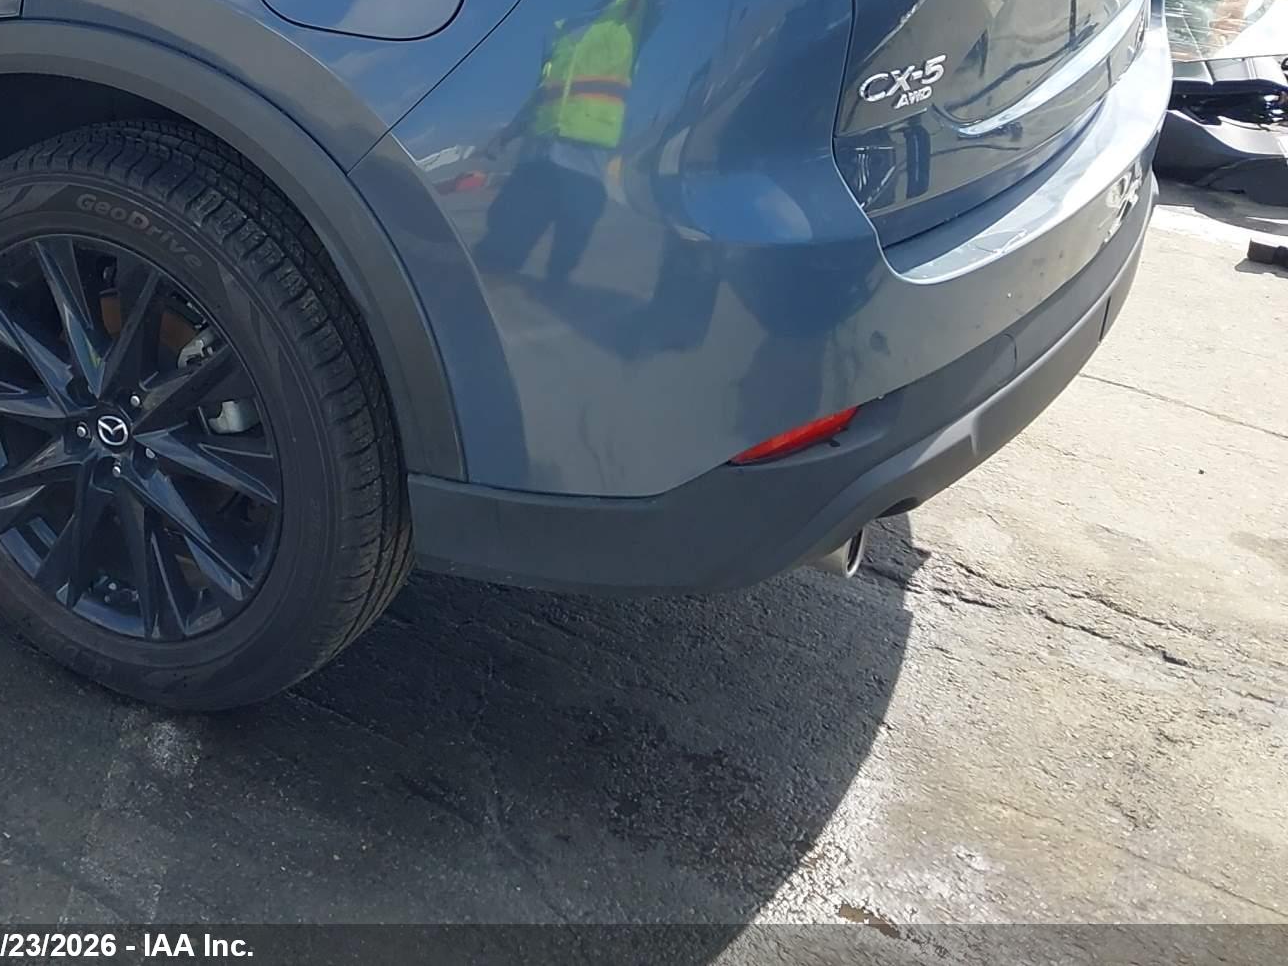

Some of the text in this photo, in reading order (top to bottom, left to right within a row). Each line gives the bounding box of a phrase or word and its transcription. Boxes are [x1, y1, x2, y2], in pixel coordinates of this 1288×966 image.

[859, 54, 946, 102] CX-5
[894, 85, 932, 109] AWD
[76, 193, 202, 267] GeoDrive
